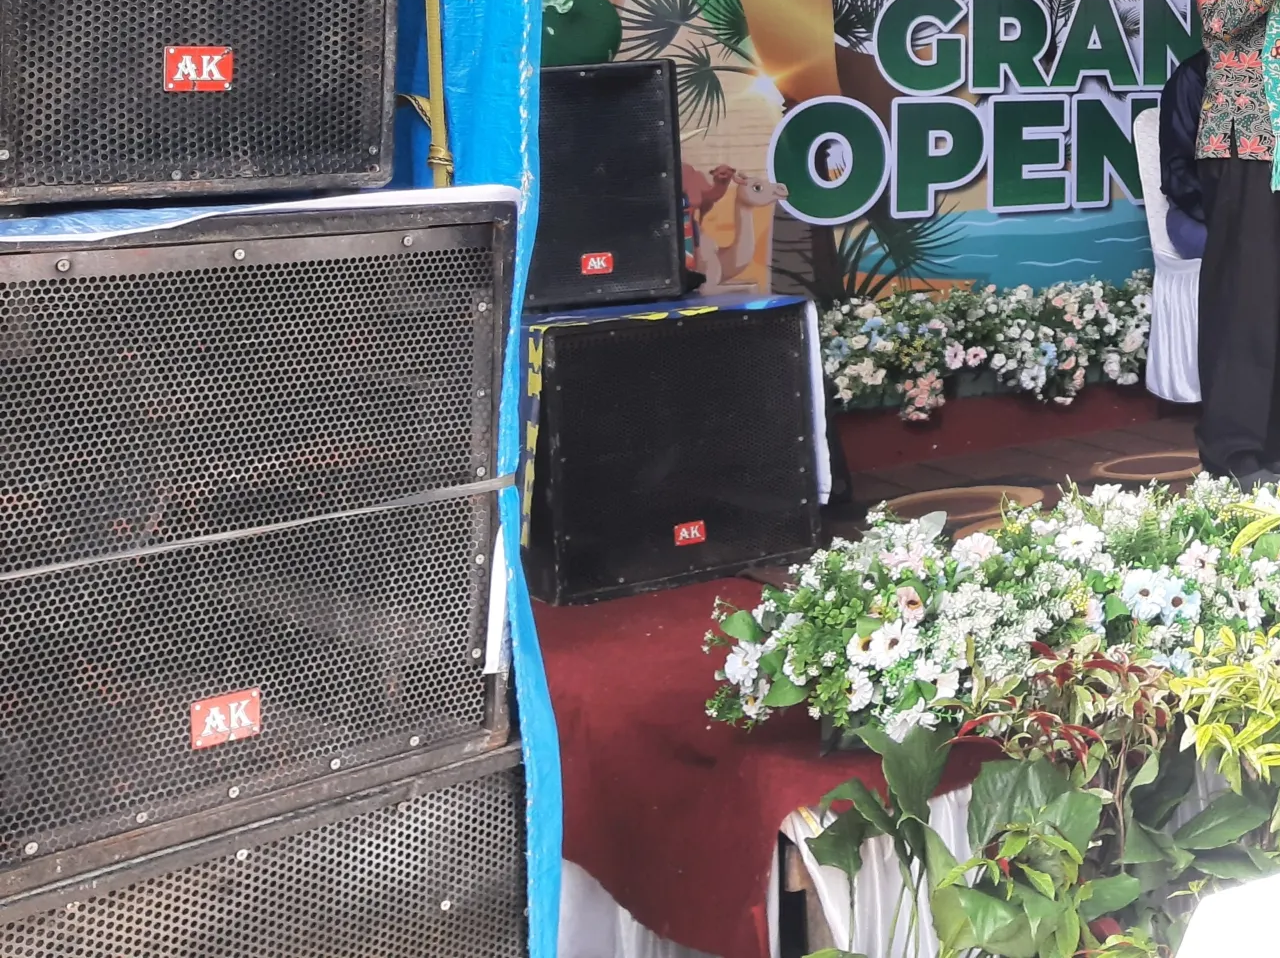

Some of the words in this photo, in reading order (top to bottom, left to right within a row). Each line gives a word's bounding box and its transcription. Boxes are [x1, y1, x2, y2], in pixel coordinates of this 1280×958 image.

[173, 55, 227, 81] AK
[767, 95, 1148, 226] OPEN
[587, 256, 608, 270] AK
[678, 523, 701, 541] AK
[201, 699, 253, 737] AK
